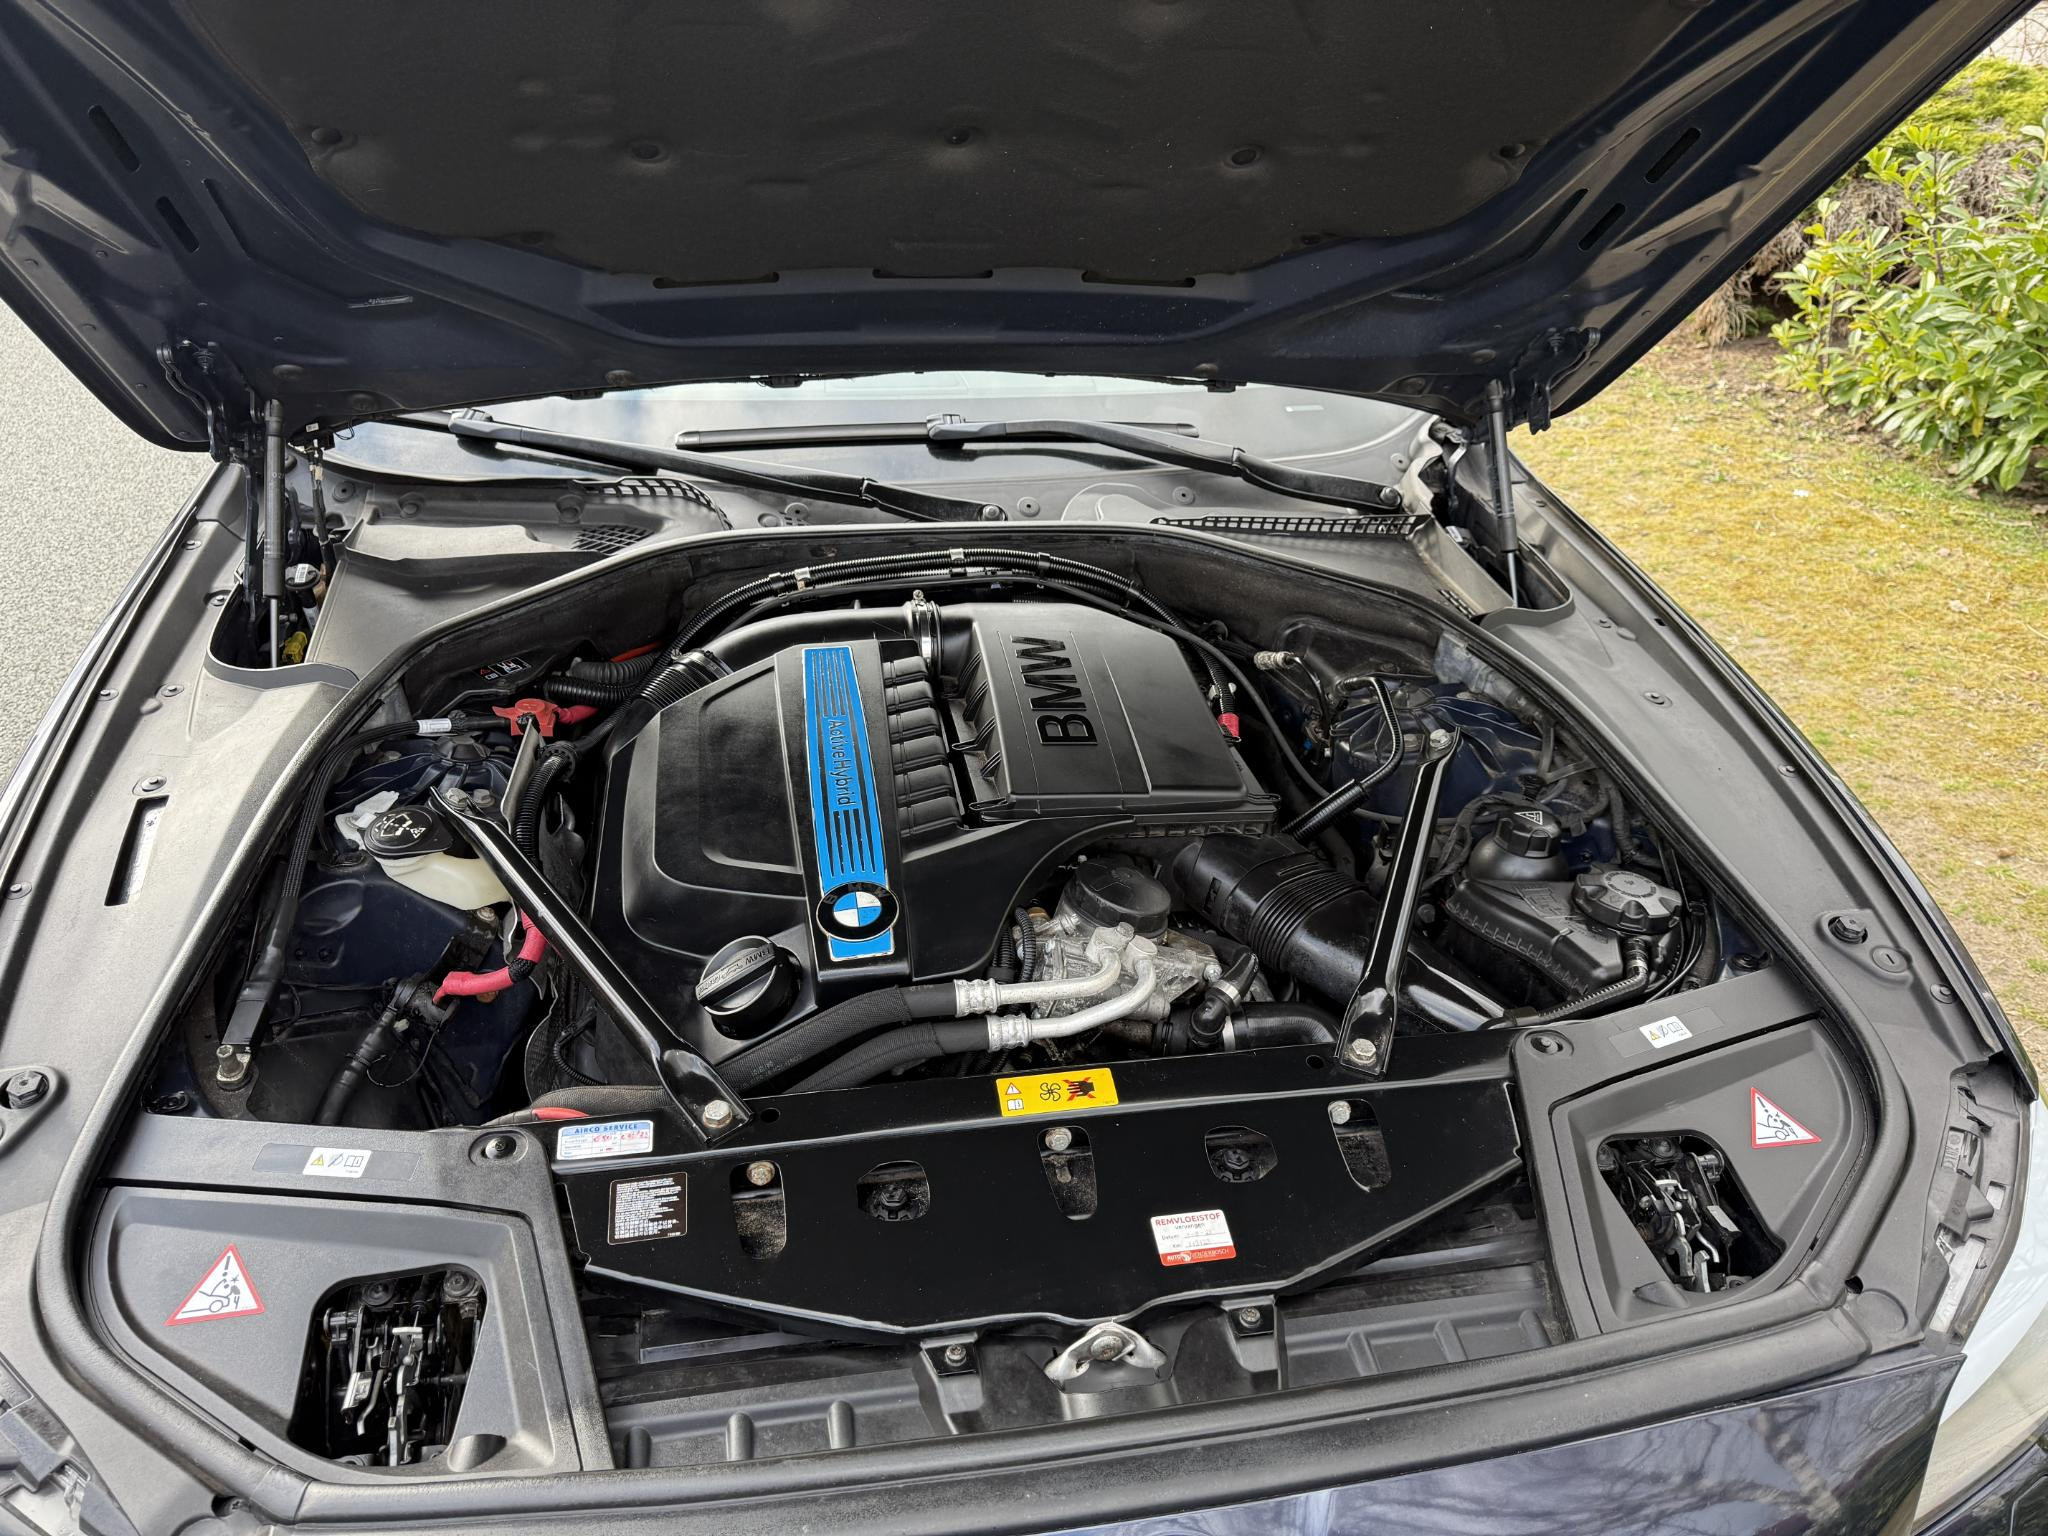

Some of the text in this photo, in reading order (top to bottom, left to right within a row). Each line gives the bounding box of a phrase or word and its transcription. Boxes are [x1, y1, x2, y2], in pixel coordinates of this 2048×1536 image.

[1010, 636, 1098, 746] BMW
[828, 719, 857, 806] ActiveHybrid
[744, 947, 773, 967] BMW
[574, 1122, 638, 1135] AIRCO SERVICE
[1155, 1212, 1221, 1226] REMVLOEISTOF
